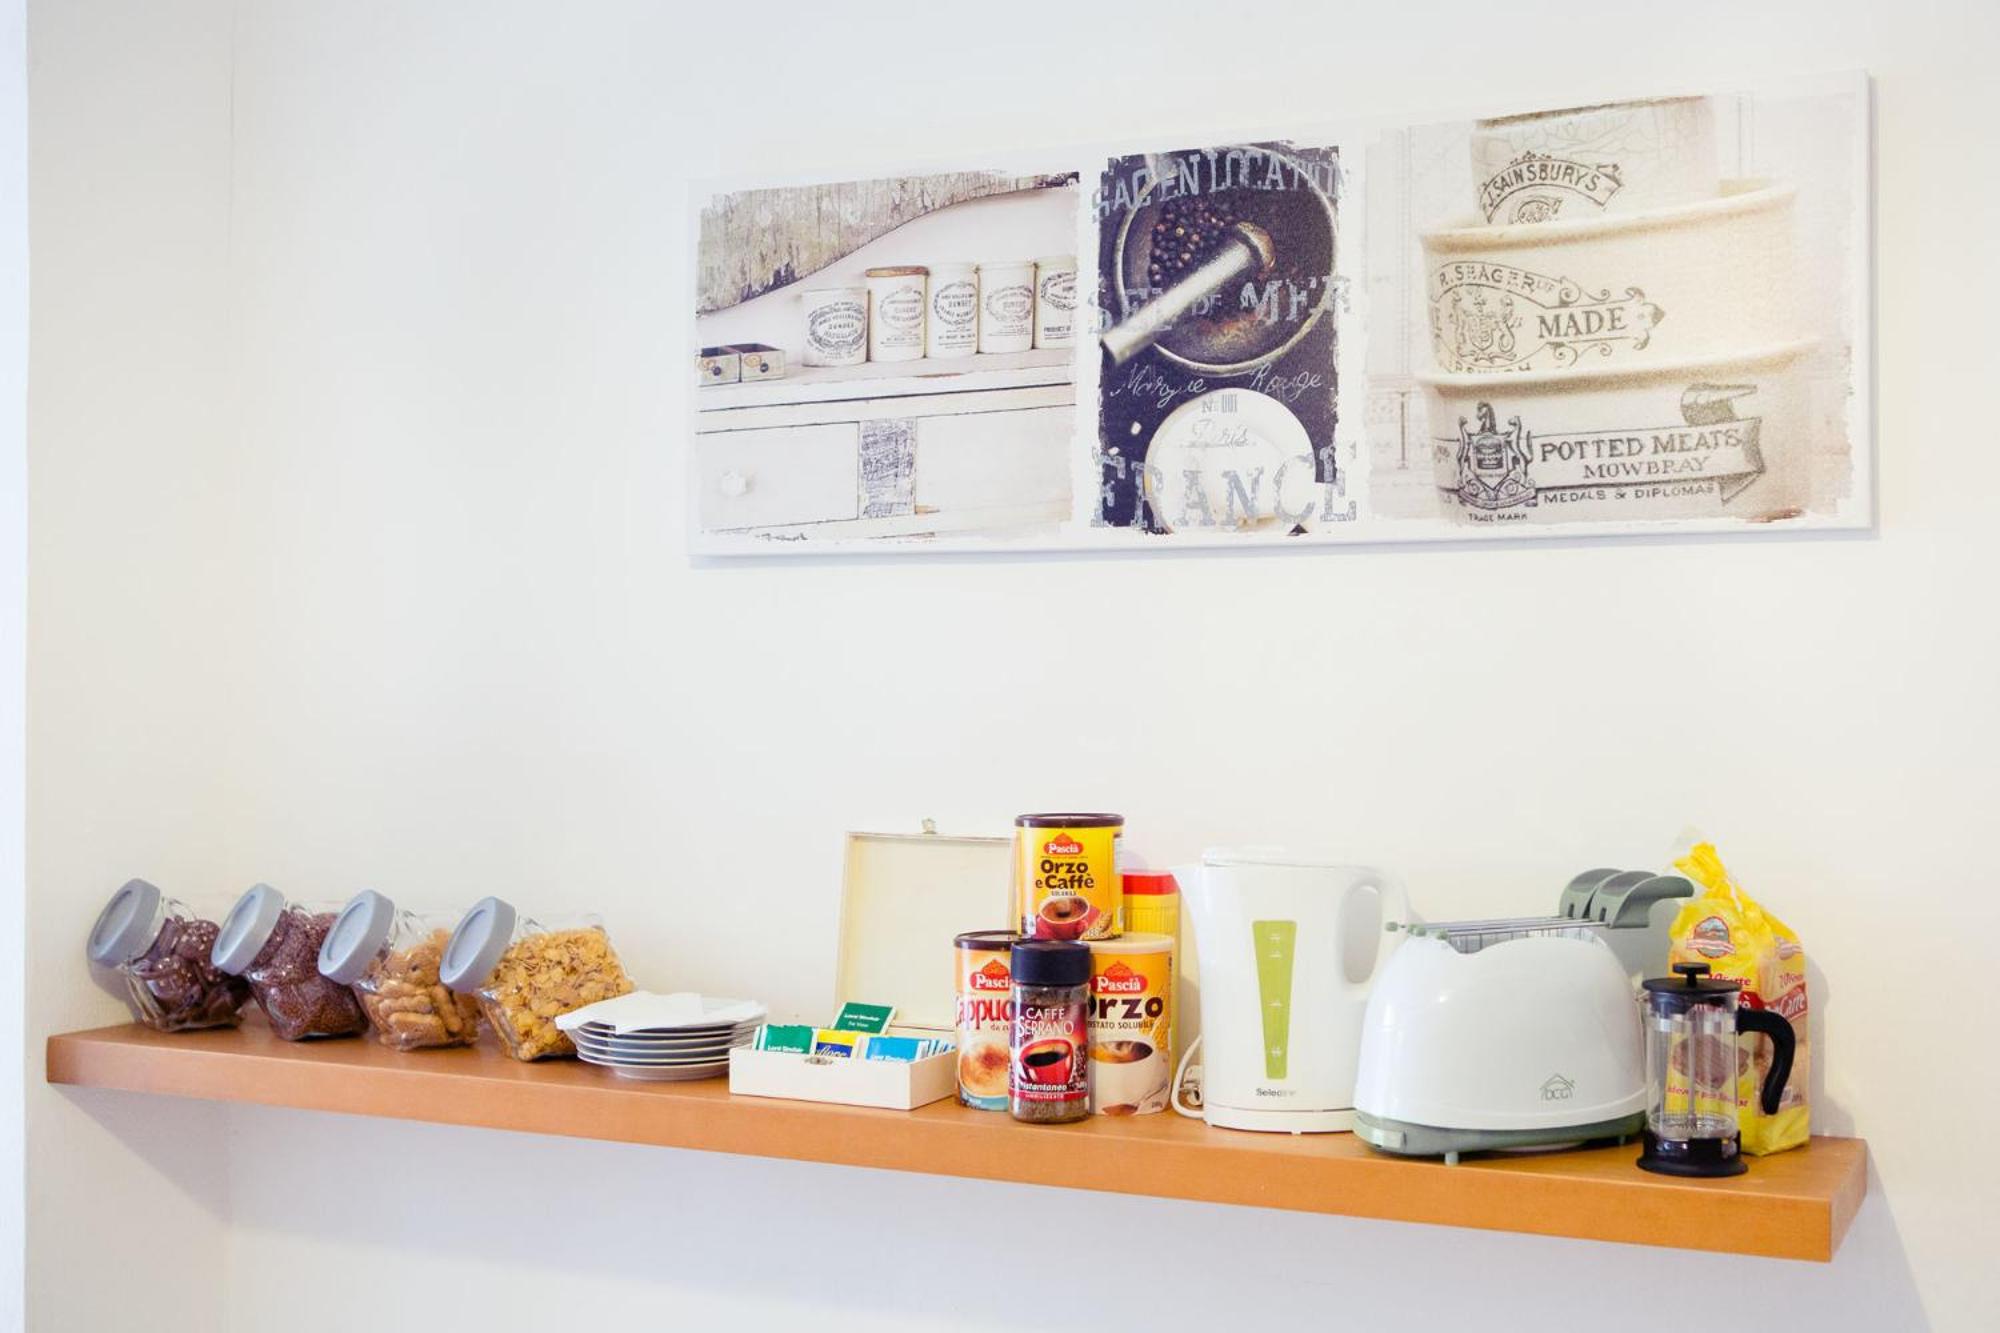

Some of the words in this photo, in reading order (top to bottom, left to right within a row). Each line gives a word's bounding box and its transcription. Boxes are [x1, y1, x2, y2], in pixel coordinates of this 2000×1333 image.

[1536, 306, 1627, 339] MADE
[1540, 437, 1644, 462] POTTED
[1652, 428, 1744, 455] MEATS
[1583, 456, 1710, 479] MOWBRAY
[1544, 490, 1607, 504] MEDALS
[1614, 488, 1627, 499] &
[1634, 481, 1716, 499] DIPLOMAS
[1048, 843, 1079, 854] Pascià
[1040, 859, 1089, 874] Orzo
[1035, 878, 1043, 889] e
[1044, 873, 1094, 889] Caffè
[974, 972, 1010, 989] Pasci
[1096, 976, 1141, 992] Pascià
[1016, 1014, 1074, 1038] SERRANO
